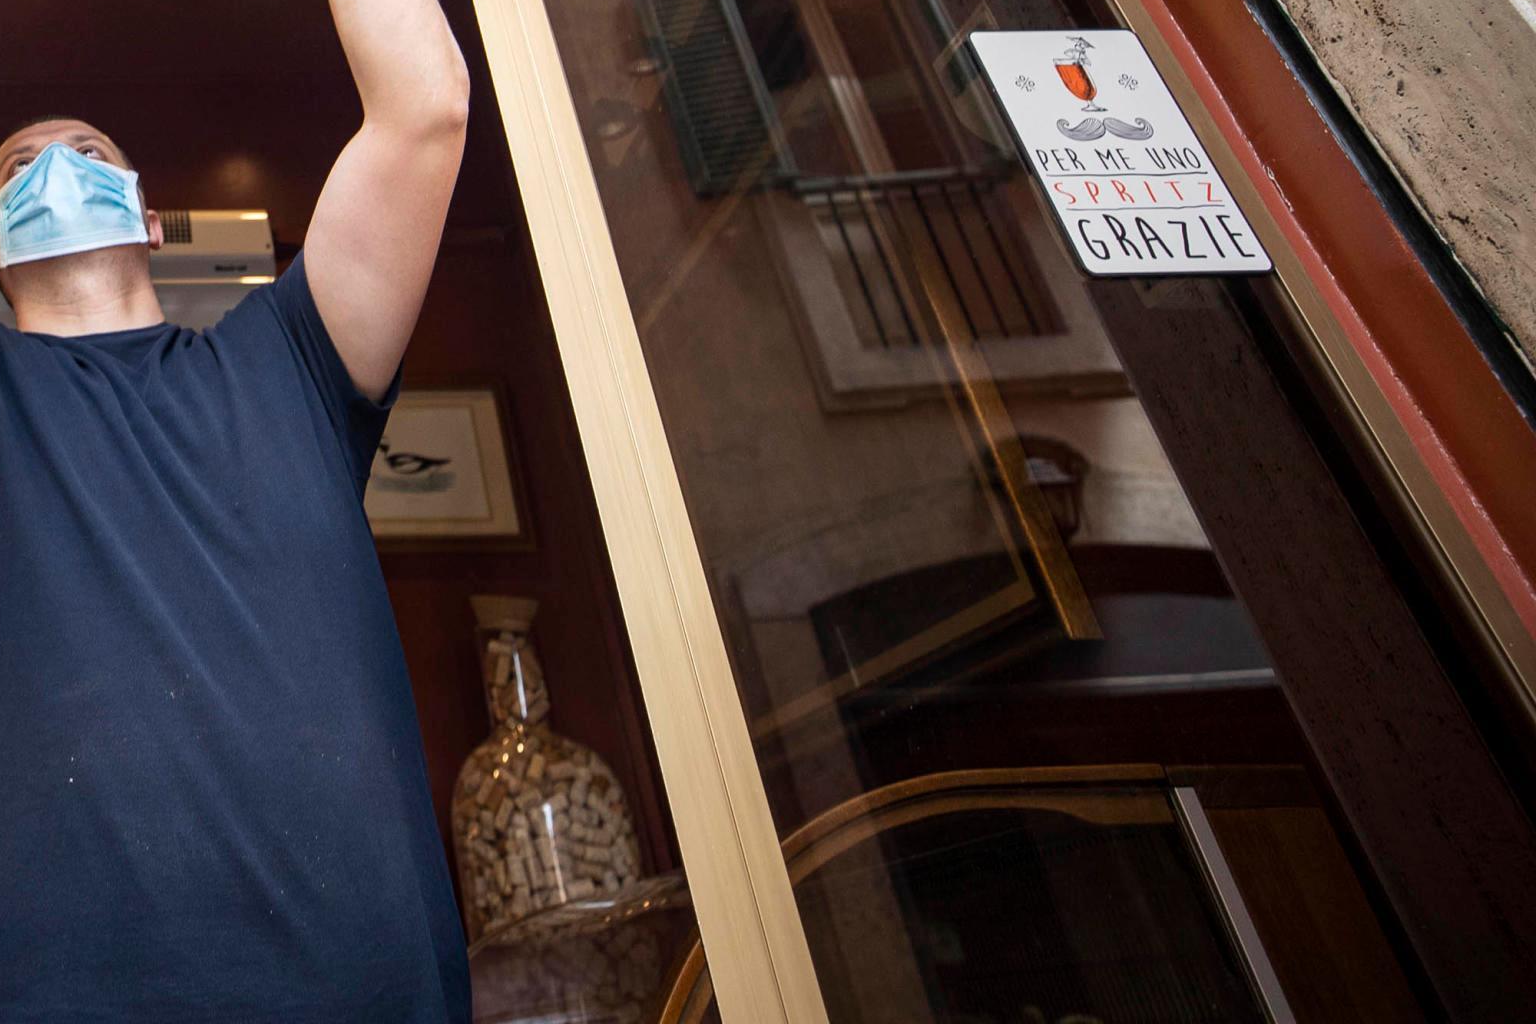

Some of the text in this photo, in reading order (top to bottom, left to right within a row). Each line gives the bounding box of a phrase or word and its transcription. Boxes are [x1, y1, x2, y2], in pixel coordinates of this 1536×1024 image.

[1036, 147, 1201, 171] PER ME UNO
[1053, 179, 1223, 204] SPRITZ
[1078, 214, 1255, 259] GRAZIE
